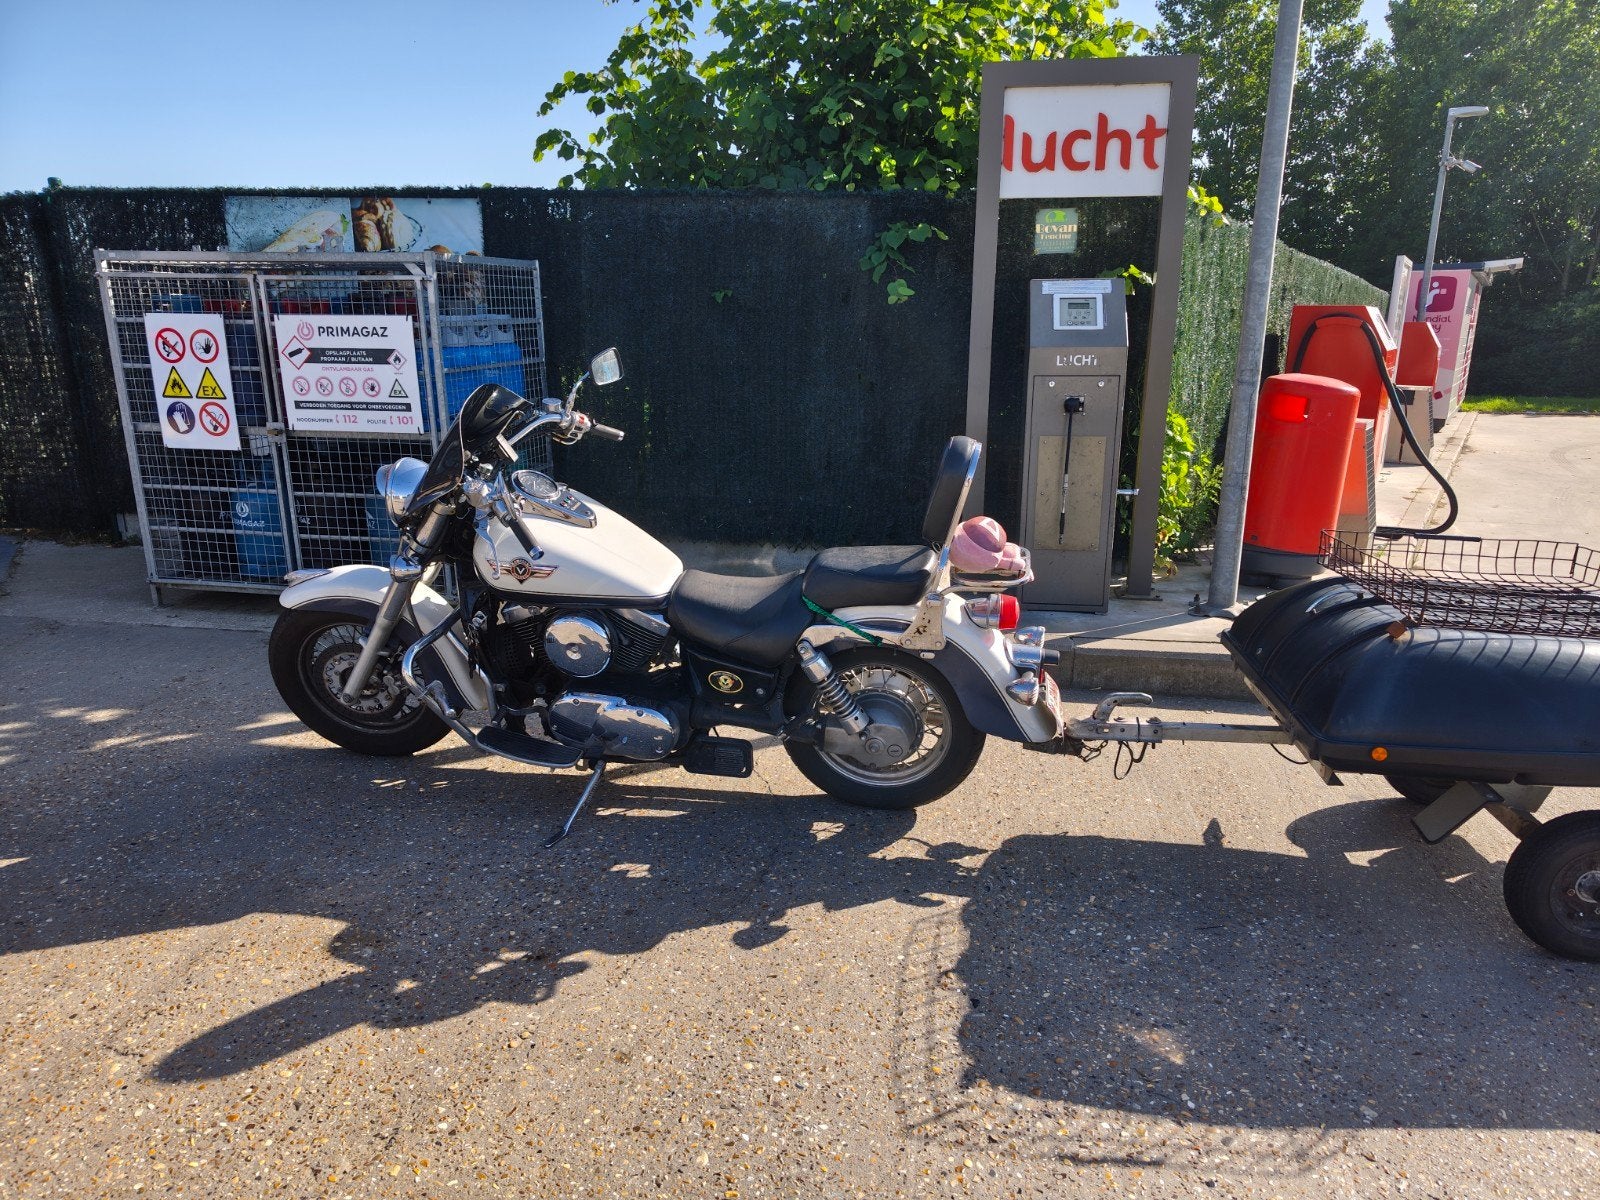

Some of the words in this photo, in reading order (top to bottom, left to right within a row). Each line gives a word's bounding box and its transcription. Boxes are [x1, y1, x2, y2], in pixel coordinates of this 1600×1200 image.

[1002, 112, 1167, 173] lucht
[317, 326, 389, 338] PRIMAGAZ
[202, 385, 219, 397] EX
[342, 415, 358, 424] 112
[396, 416, 414, 425] 101
